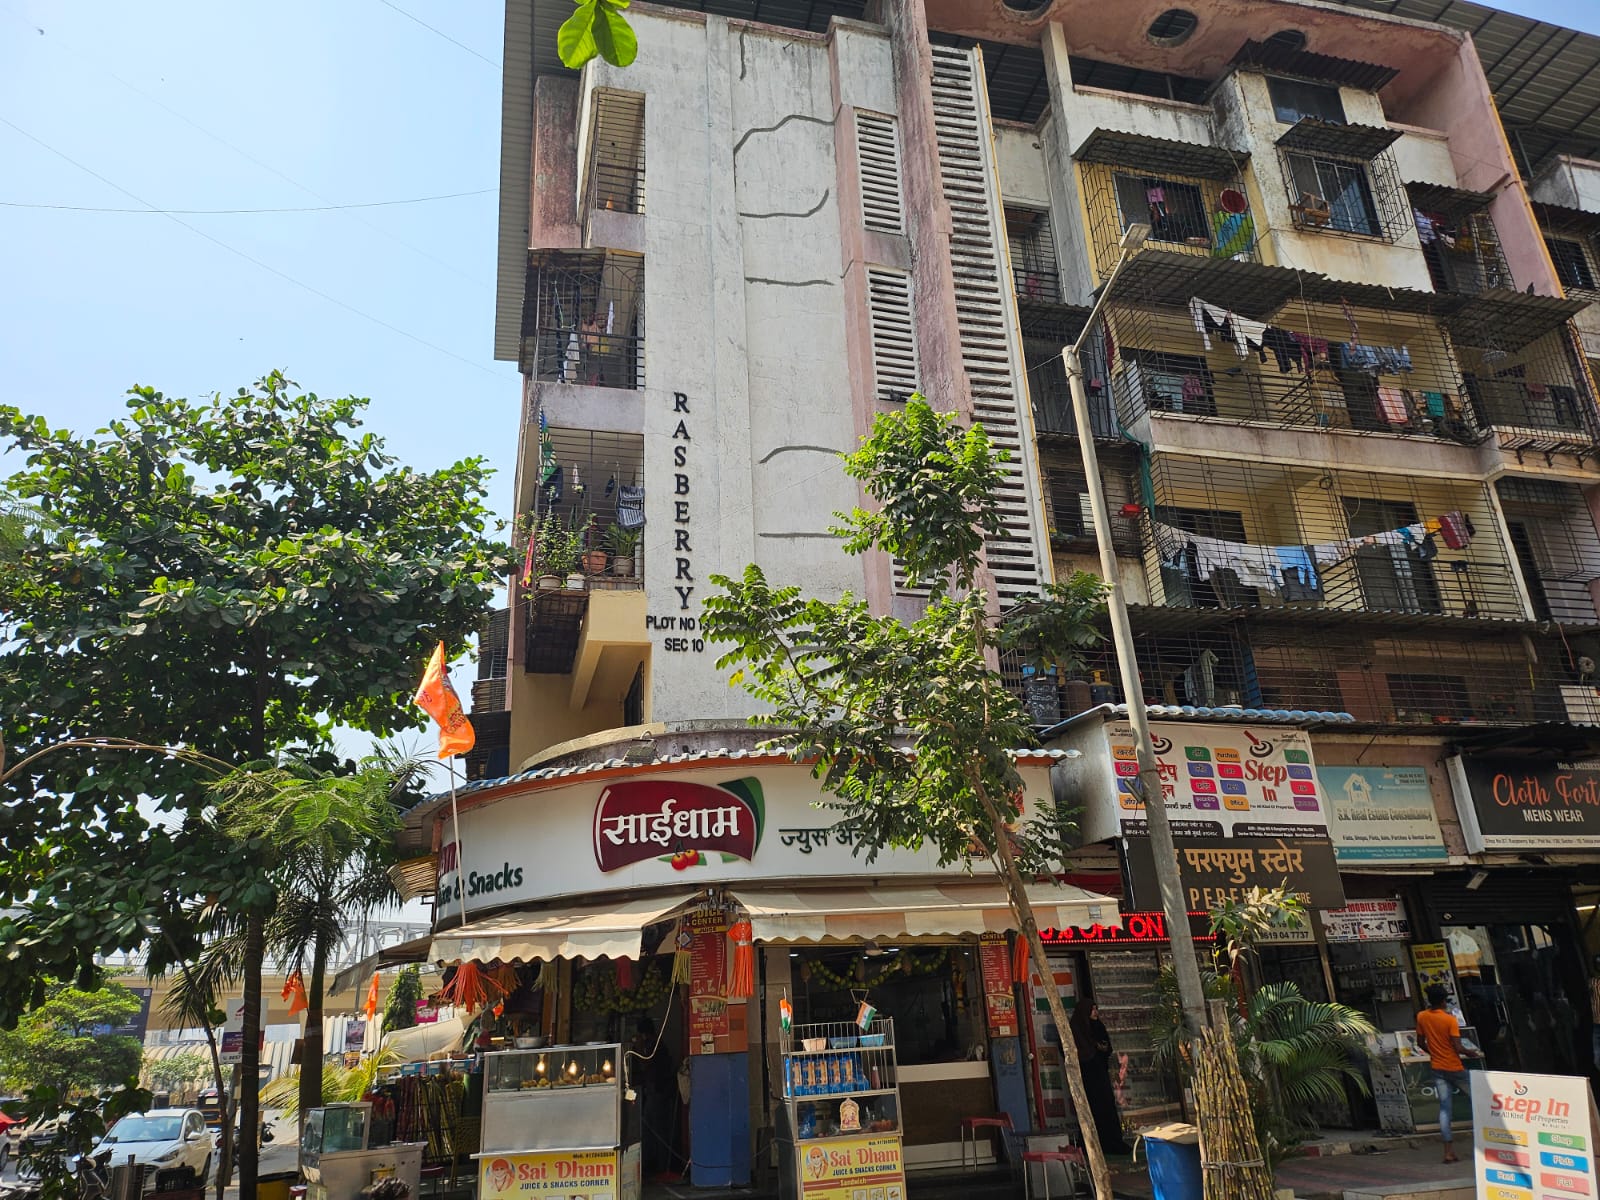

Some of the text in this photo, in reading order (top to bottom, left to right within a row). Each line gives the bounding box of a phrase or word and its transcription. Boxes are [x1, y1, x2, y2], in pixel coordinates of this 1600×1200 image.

[672, 391, 695, 610] RASBERRY
[646, 615, 676, 630] PLOT
[680, 617, 696, 631] NO
[665, 637, 704, 653] SEC 10
[1245, 759, 1288, 787] Step
[1262, 785, 1278, 802] In
[1492, 774, 1551, 807] Cloth
[602, 798, 742, 847] साईधाम
[1523, 809, 1585, 823] MENS WEAR
[779, 828, 829, 853] ज्युस
[1184, 848, 1256, 884] परफ्युम
[1258, 839, 1305, 874] स्टोर
[468, 861, 523, 896] Snacks
[1347, 902, 1376, 913] MOBILE
[1378, 901, 1397, 912] SHOP
[691, 916, 723, 926] CENTER
[1129, 915, 1164, 938] ON
[1490, 1094, 1570, 1123] Step In
[1510, 1112, 1524, 1120] Kind
[1538, 1115, 1569, 1125] Properties
[830, 1146, 899, 1167] Sai Dham
[518, 1160, 614, 1181] Sai Dham
[833, 1168, 848, 1176] JUICE
[520, 1182, 541, 1190] JUICE
[550, 1180, 578, 1188] SNACKS
[580, 1178, 610, 1187] CORNER
